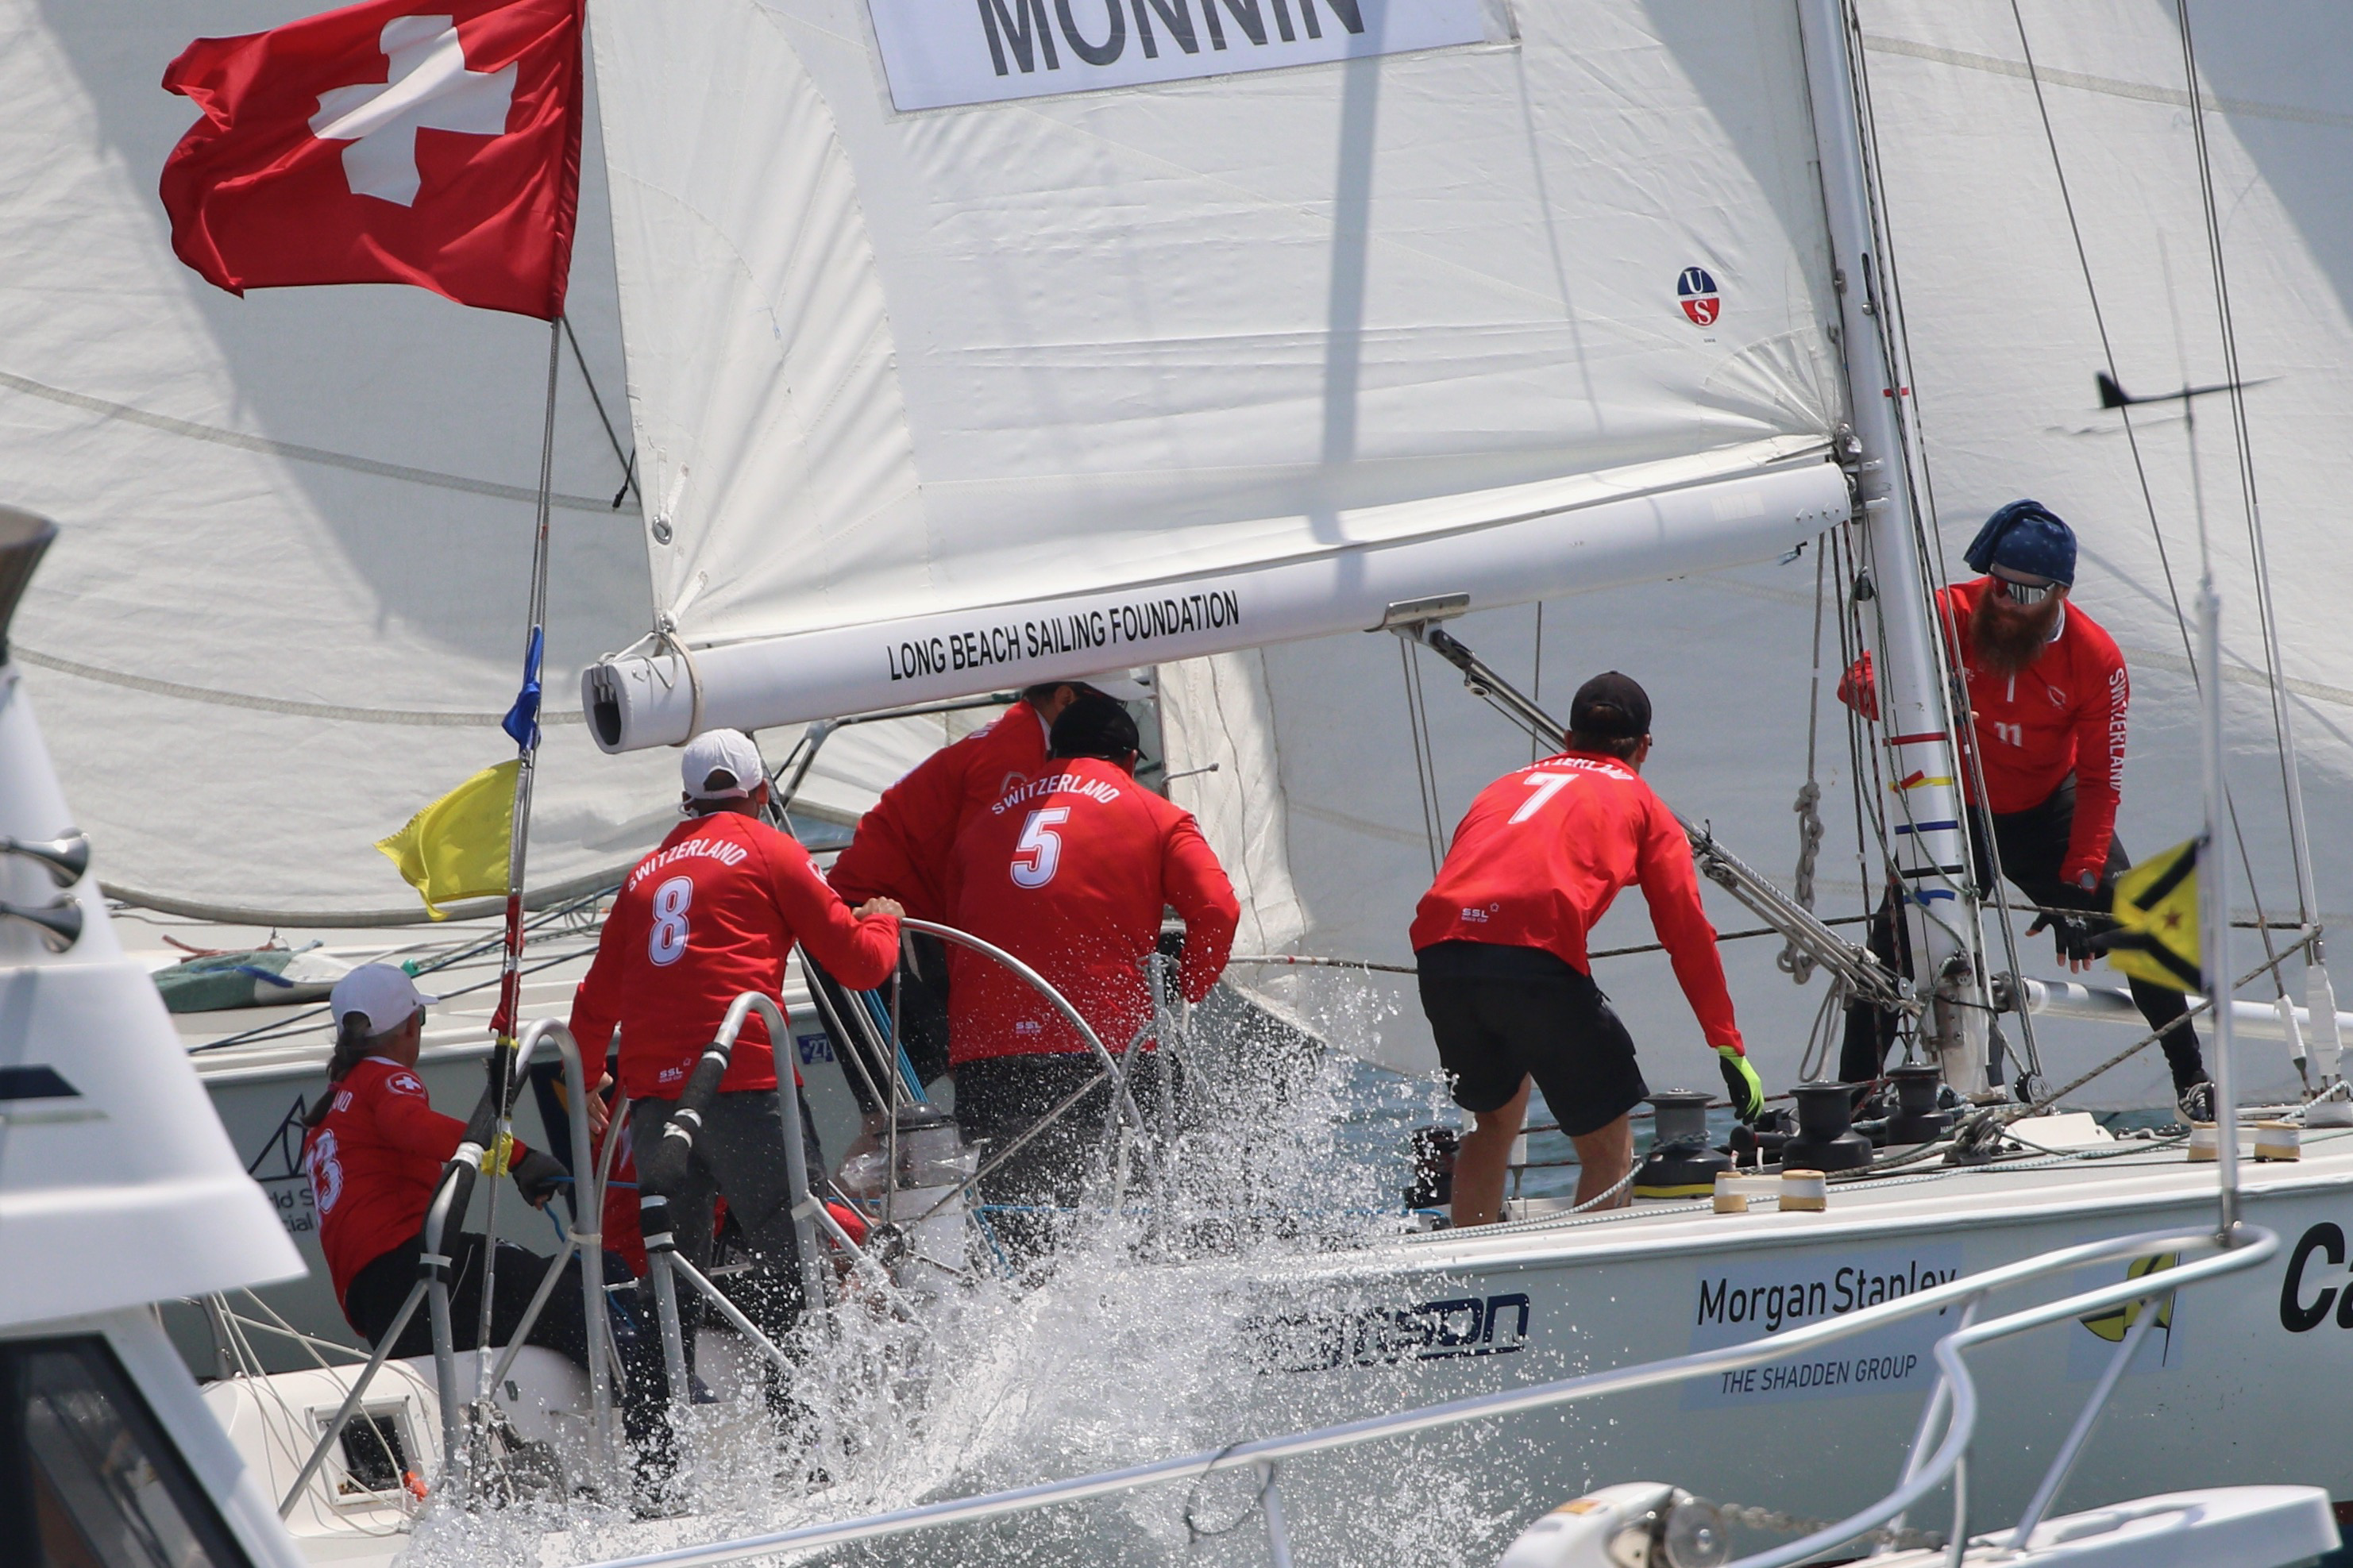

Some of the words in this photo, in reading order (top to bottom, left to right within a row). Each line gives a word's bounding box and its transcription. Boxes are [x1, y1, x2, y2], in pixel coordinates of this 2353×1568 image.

[887, 638, 946, 680] LONG
[949, 622, 1021, 670] BEACH
[1026, 611, 1105, 657] SAILING
[1109, 590, 1240, 644] FOUNDATION
[1993, 720, 2023, 747] 11
[991, 773, 1121, 815] SWITZERLAND
[1507, 771, 1580, 824] 7
[628, 838, 747, 892] SWITZERLAND
[1010, 807, 1070, 889] 5
[648, 876, 693, 967] 8
[1462, 907, 1489, 919] SSL
[660, 1067, 683, 1078] SSL
[1698, 1278, 1826, 1331] Morgan
[1721, 1369, 1755, 1394] THE
[1761, 1361, 1850, 1391] SHADDEN
[1855, 1354, 1918, 1383] GROUP
